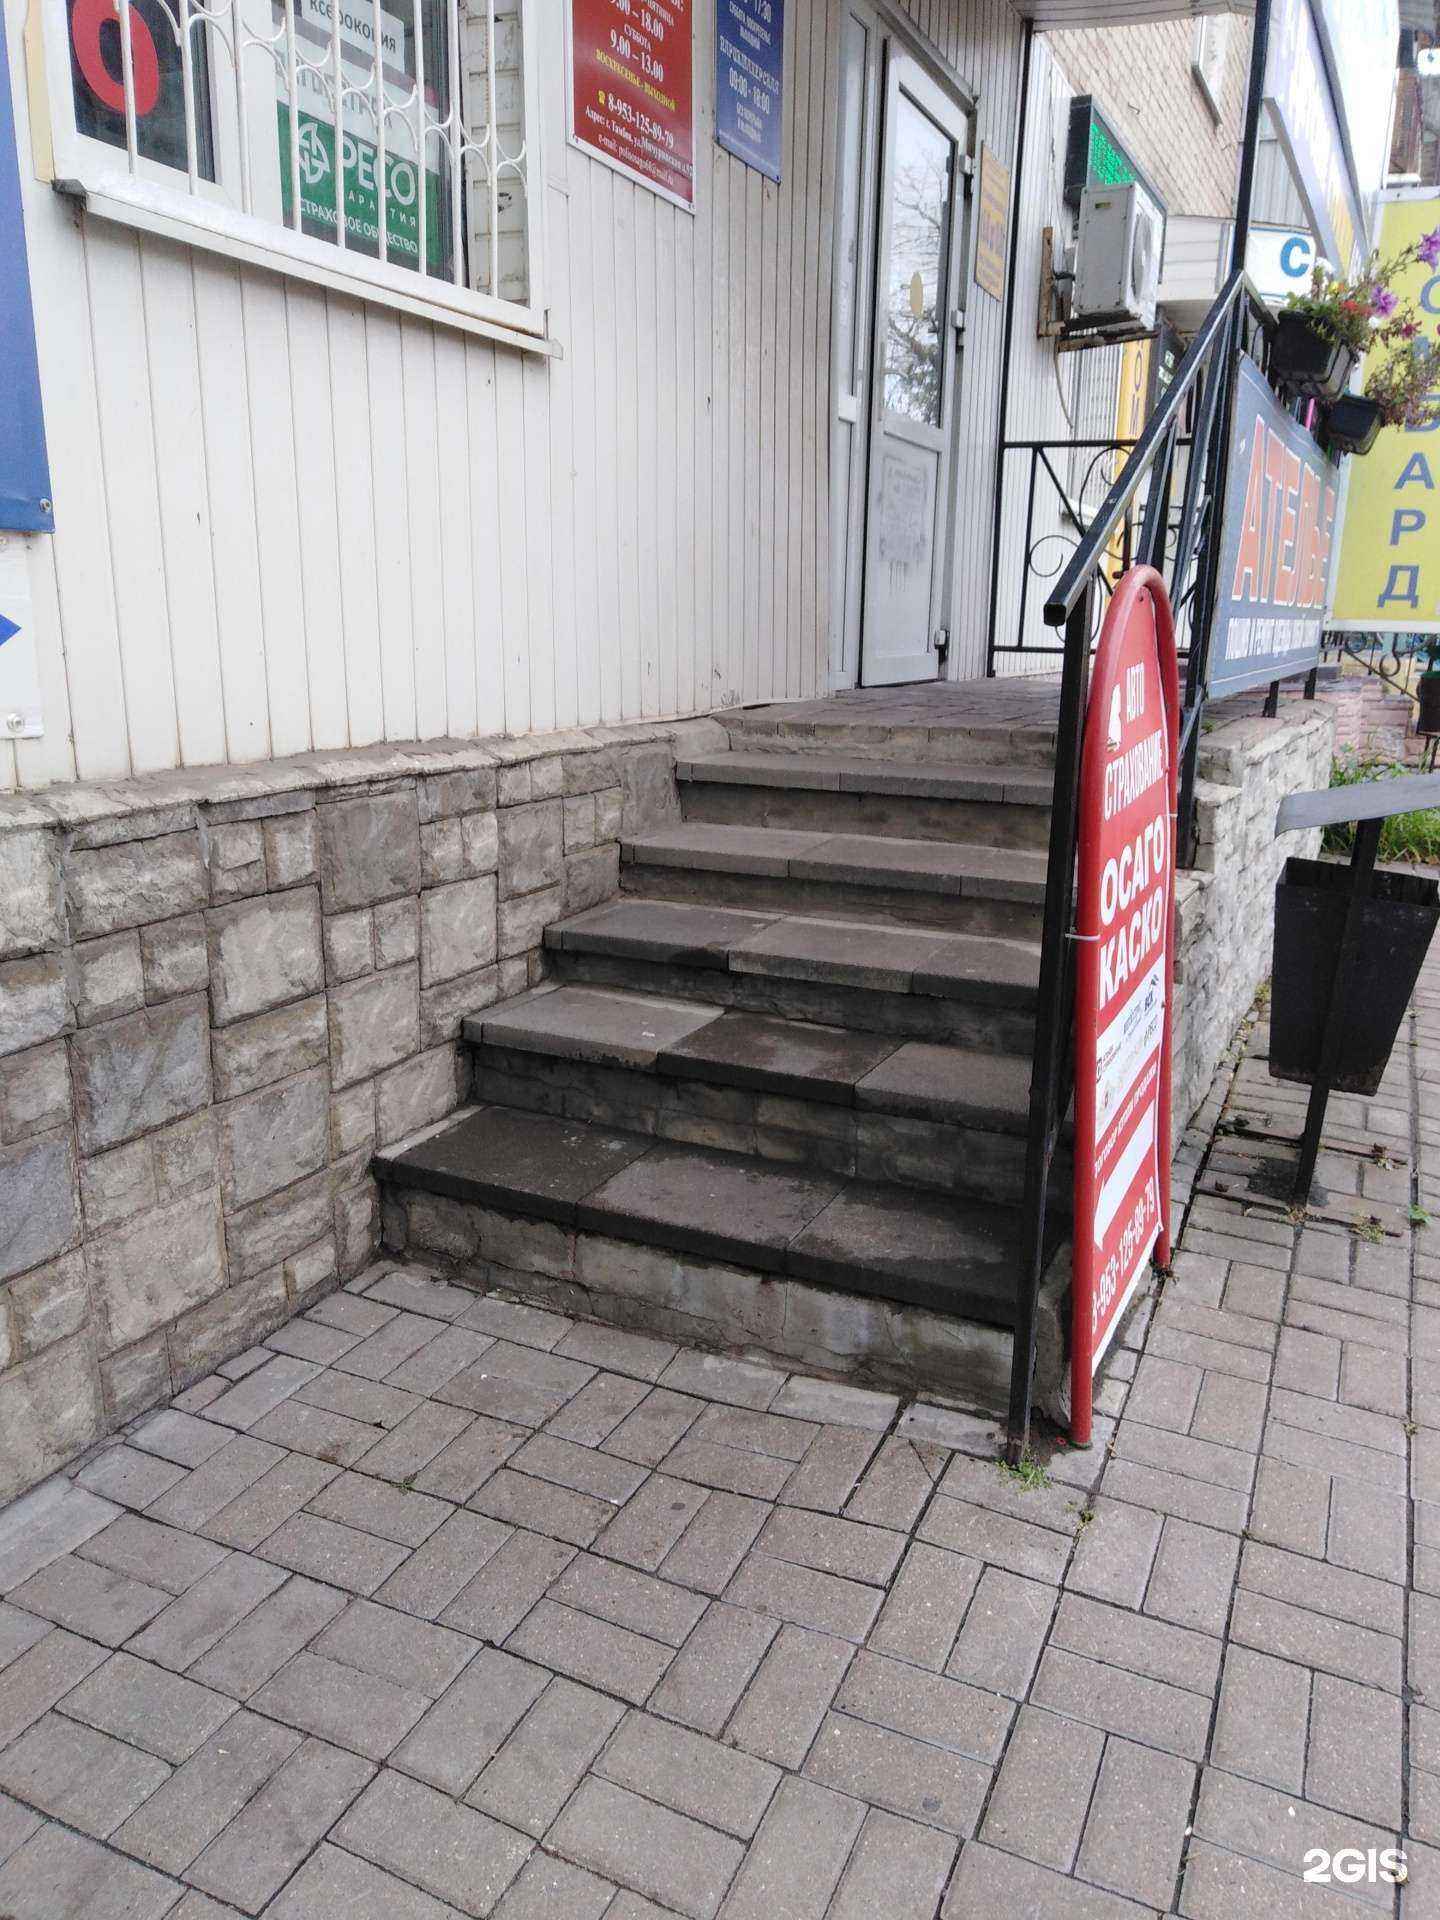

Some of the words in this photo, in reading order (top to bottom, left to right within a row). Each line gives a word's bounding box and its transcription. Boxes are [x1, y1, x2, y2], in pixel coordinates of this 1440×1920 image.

[624, 23, 652, 52] СУББОТА
[641, 8, 664, 42] 18.00
[610, 28, 631, 59] 9.00
[641, 51, 664, 82] 13.00
[607, 92, 675, 149] 8-953-125-89-79
[349, 190, 416, 227] АРАТИЯ
[1232, 414, 1335, 609] АТЕЛЬЕ
[1127, 662, 1145, 723] АВТО
[1104, 729, 1163, 821] СТРАХОВАНИЕ
[1101, 815, 1165, 926] ОСАГО
[1099, 886, 1164, 1012] КАСКО
